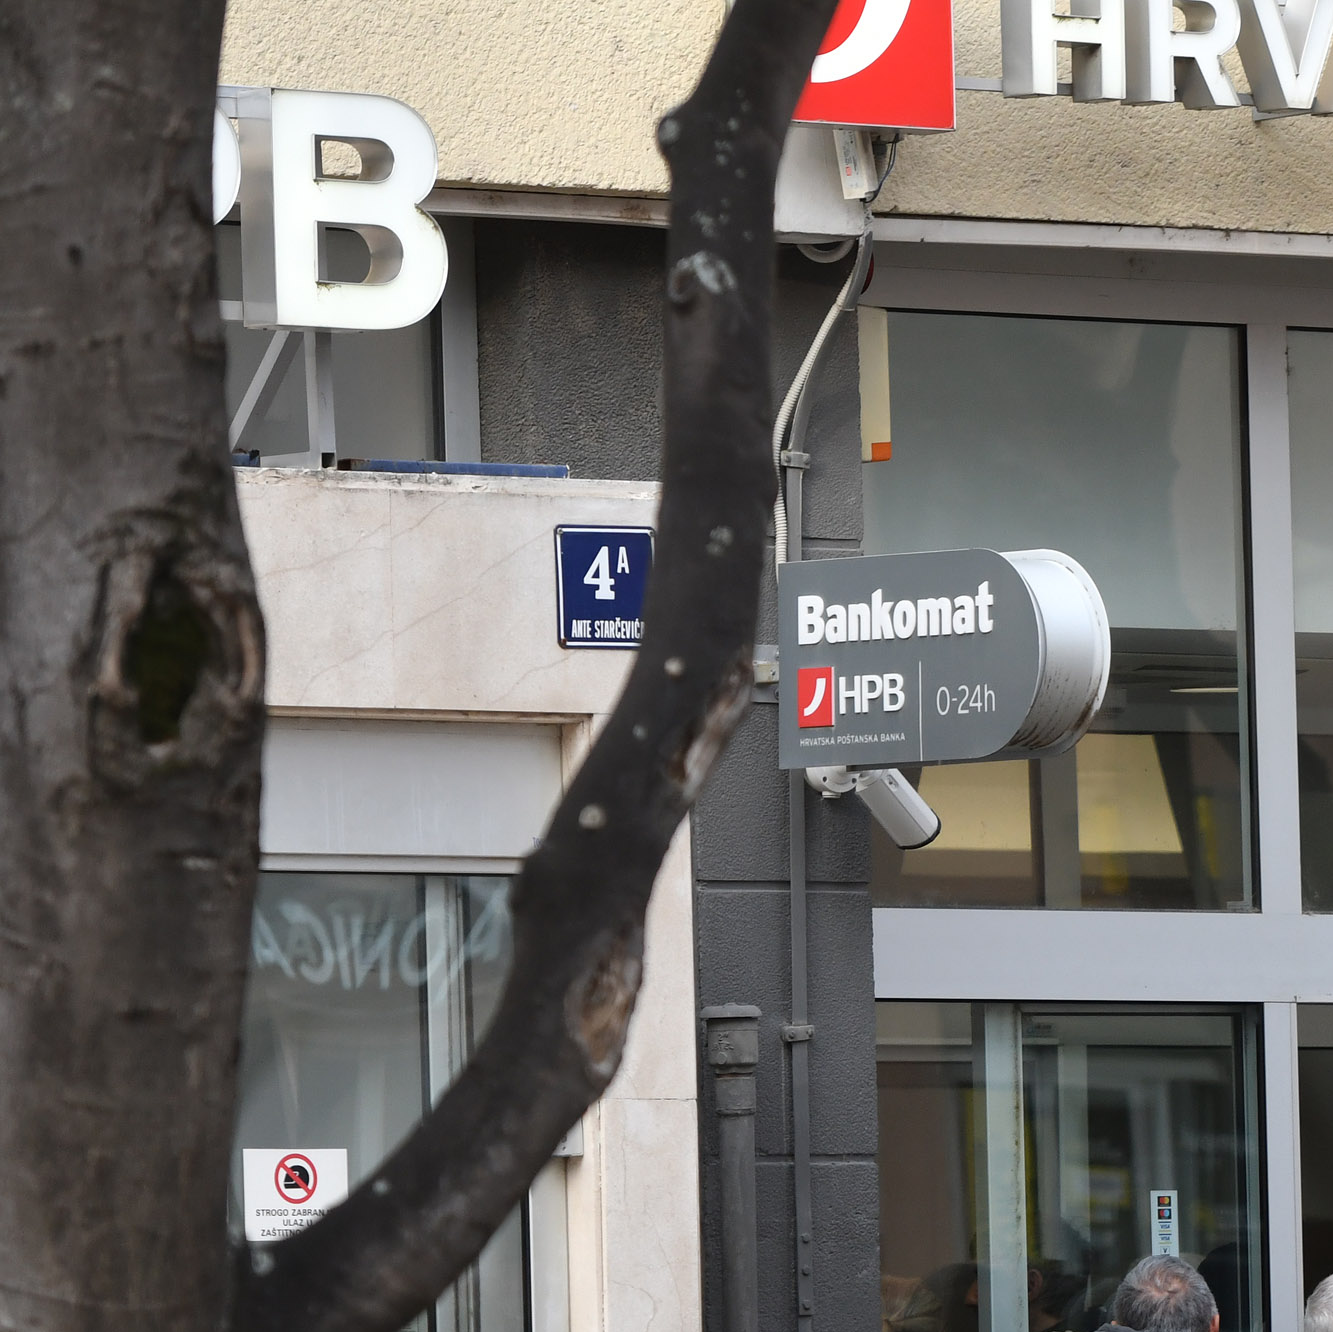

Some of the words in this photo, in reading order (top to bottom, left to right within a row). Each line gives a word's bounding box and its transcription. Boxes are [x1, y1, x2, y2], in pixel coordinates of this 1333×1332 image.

[214, 87, 448, 331] B
[797, 580, 994, 645] Bankomat
[571, 619, 592, 638] ANTE
[838, 672, 906, 715] HPB
[936, 683, 996, 716] 0-24h
[800, 736, 835, 747] HRVATSKA
[837, 733, 879, 745] POŠTANSKA
[880, 732, 906, 743] BANKA
[255, 1208, 289, 1217] STROGO
[282, 1218, 304, 1227] ULAZ
